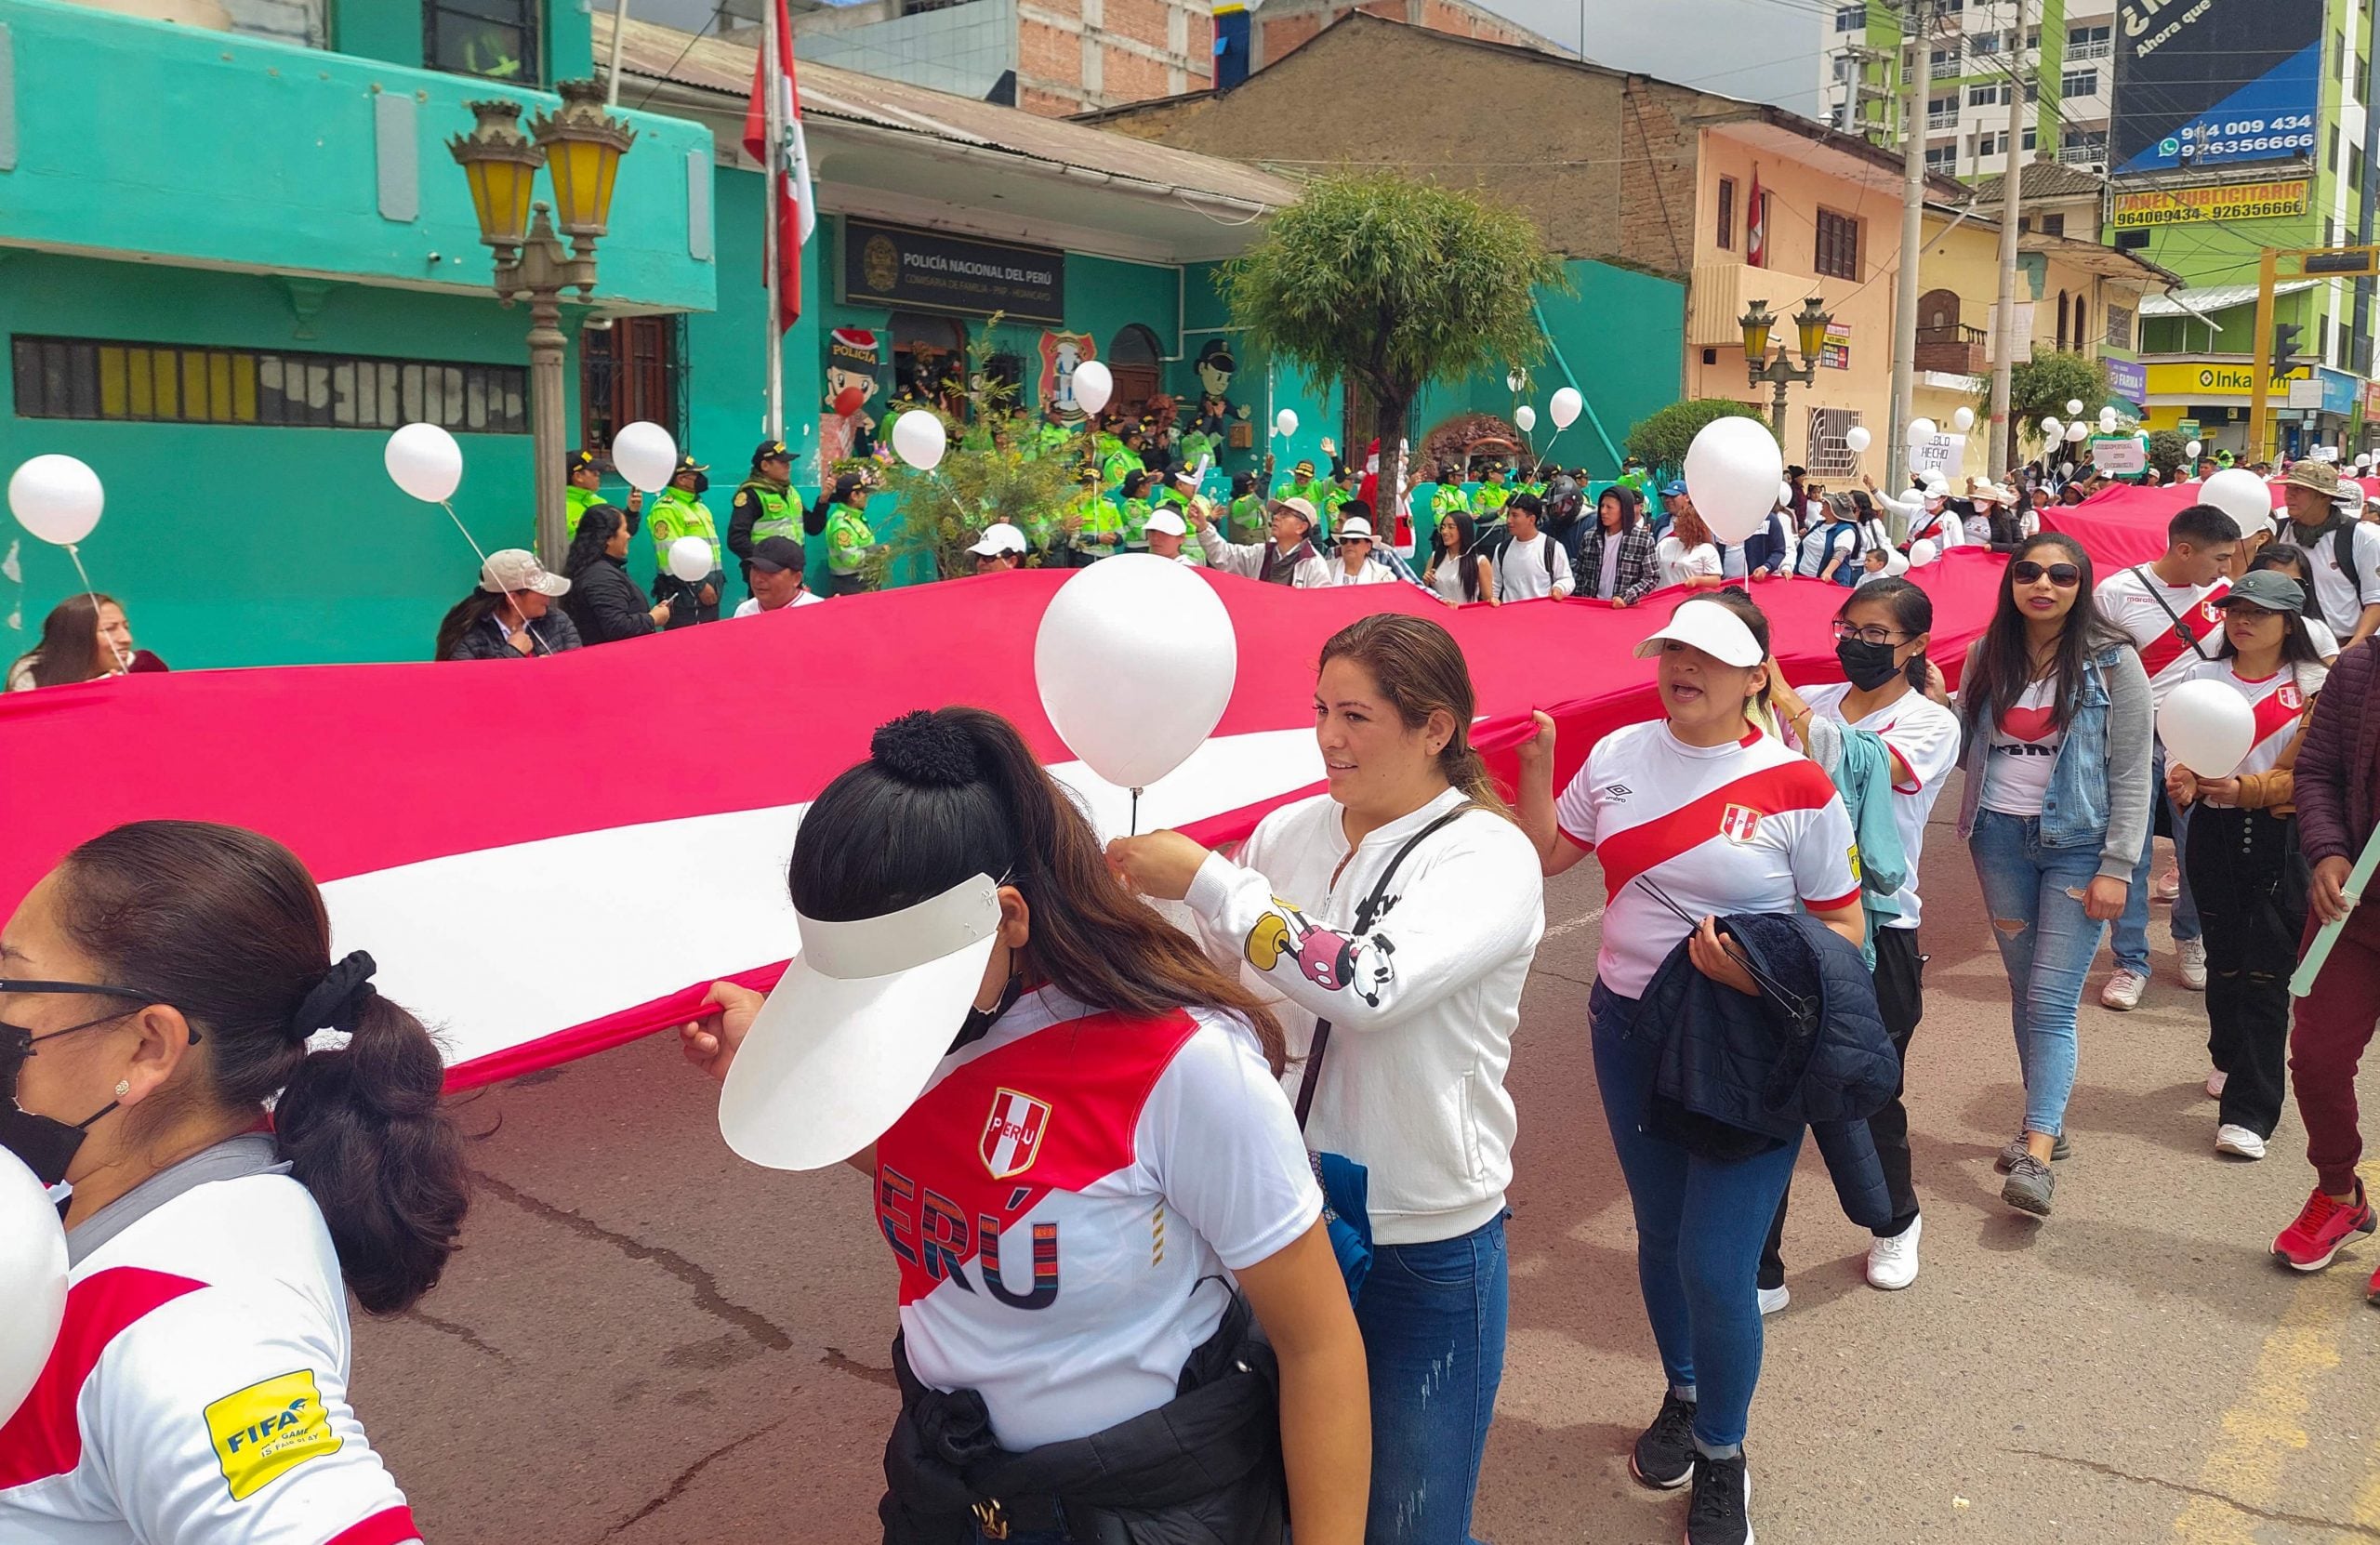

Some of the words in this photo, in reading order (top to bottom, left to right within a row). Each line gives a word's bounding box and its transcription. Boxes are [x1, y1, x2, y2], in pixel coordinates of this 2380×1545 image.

[2136, 21, 2182, 58] Ahora
[2182, 0, 2212, 23] que
[2225, 120, 2265, 135] 009
[2270, 114, 2312, 130] 434
[2181, 134, 2314, 157] 926356666
[2118, 191, 2170, 211] PANEL
[2175, 182, 2305, 206] PUBLICITARIO
[2213, 201, 2302, 218] 926356666
[904, 253, 947, 271] POLICÍA
[949, 260, 1003, 279] NACIONAL
[1005, 268, 1024, 282] DEL
[1026, 271, 1052, 285] PERÚ
[2119, 373, 2138, 389] FARMA
[2216, 370, 2302, 389] Inkarm
[1922, 447, 1949, 459] HECHO
[2126, 596, 2159, 604] marath
[989, 1116, 1035, 1145] PERU
[880, 1164, 1059, 1310] ERÚ
[227, 1409, 298, 1454] FIFA
[282, 1428, 310, 1439] GAME
[261, 1448, 271, 1458] IS
